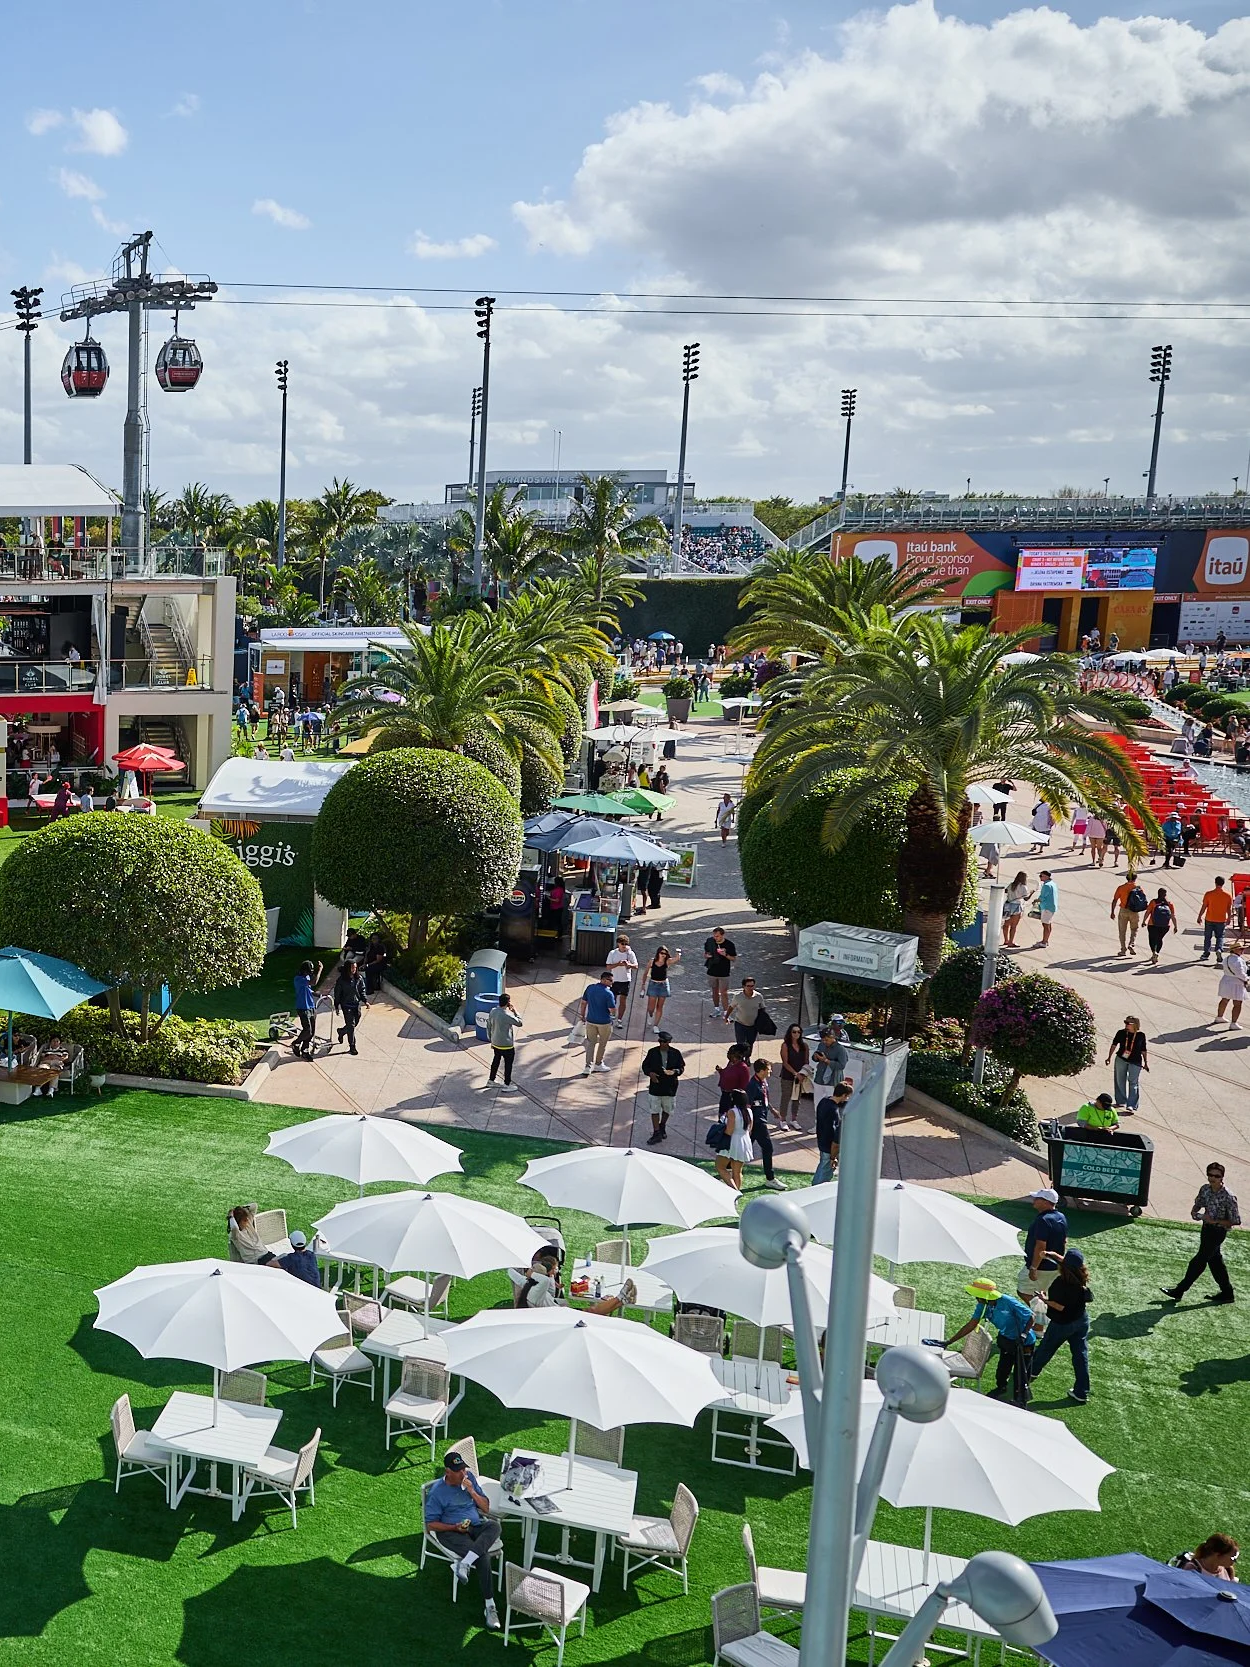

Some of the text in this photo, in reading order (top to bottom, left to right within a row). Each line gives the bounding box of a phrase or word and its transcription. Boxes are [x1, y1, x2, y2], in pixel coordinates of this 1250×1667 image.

[499, 475, 564, 484] GRANDSTAND
[906, 541, 957, 553] Itaú bank
[905, 553, 975, 567] Proud sponsor
[1208, 557, 1244, 575] itaú
[947, 564, 970, 576] than
[228, 839, 296, 868] iggi's
[842, 953, 874, 965] INFORMATION
[1082, 1164, 1120, 1175] COLD BEER
